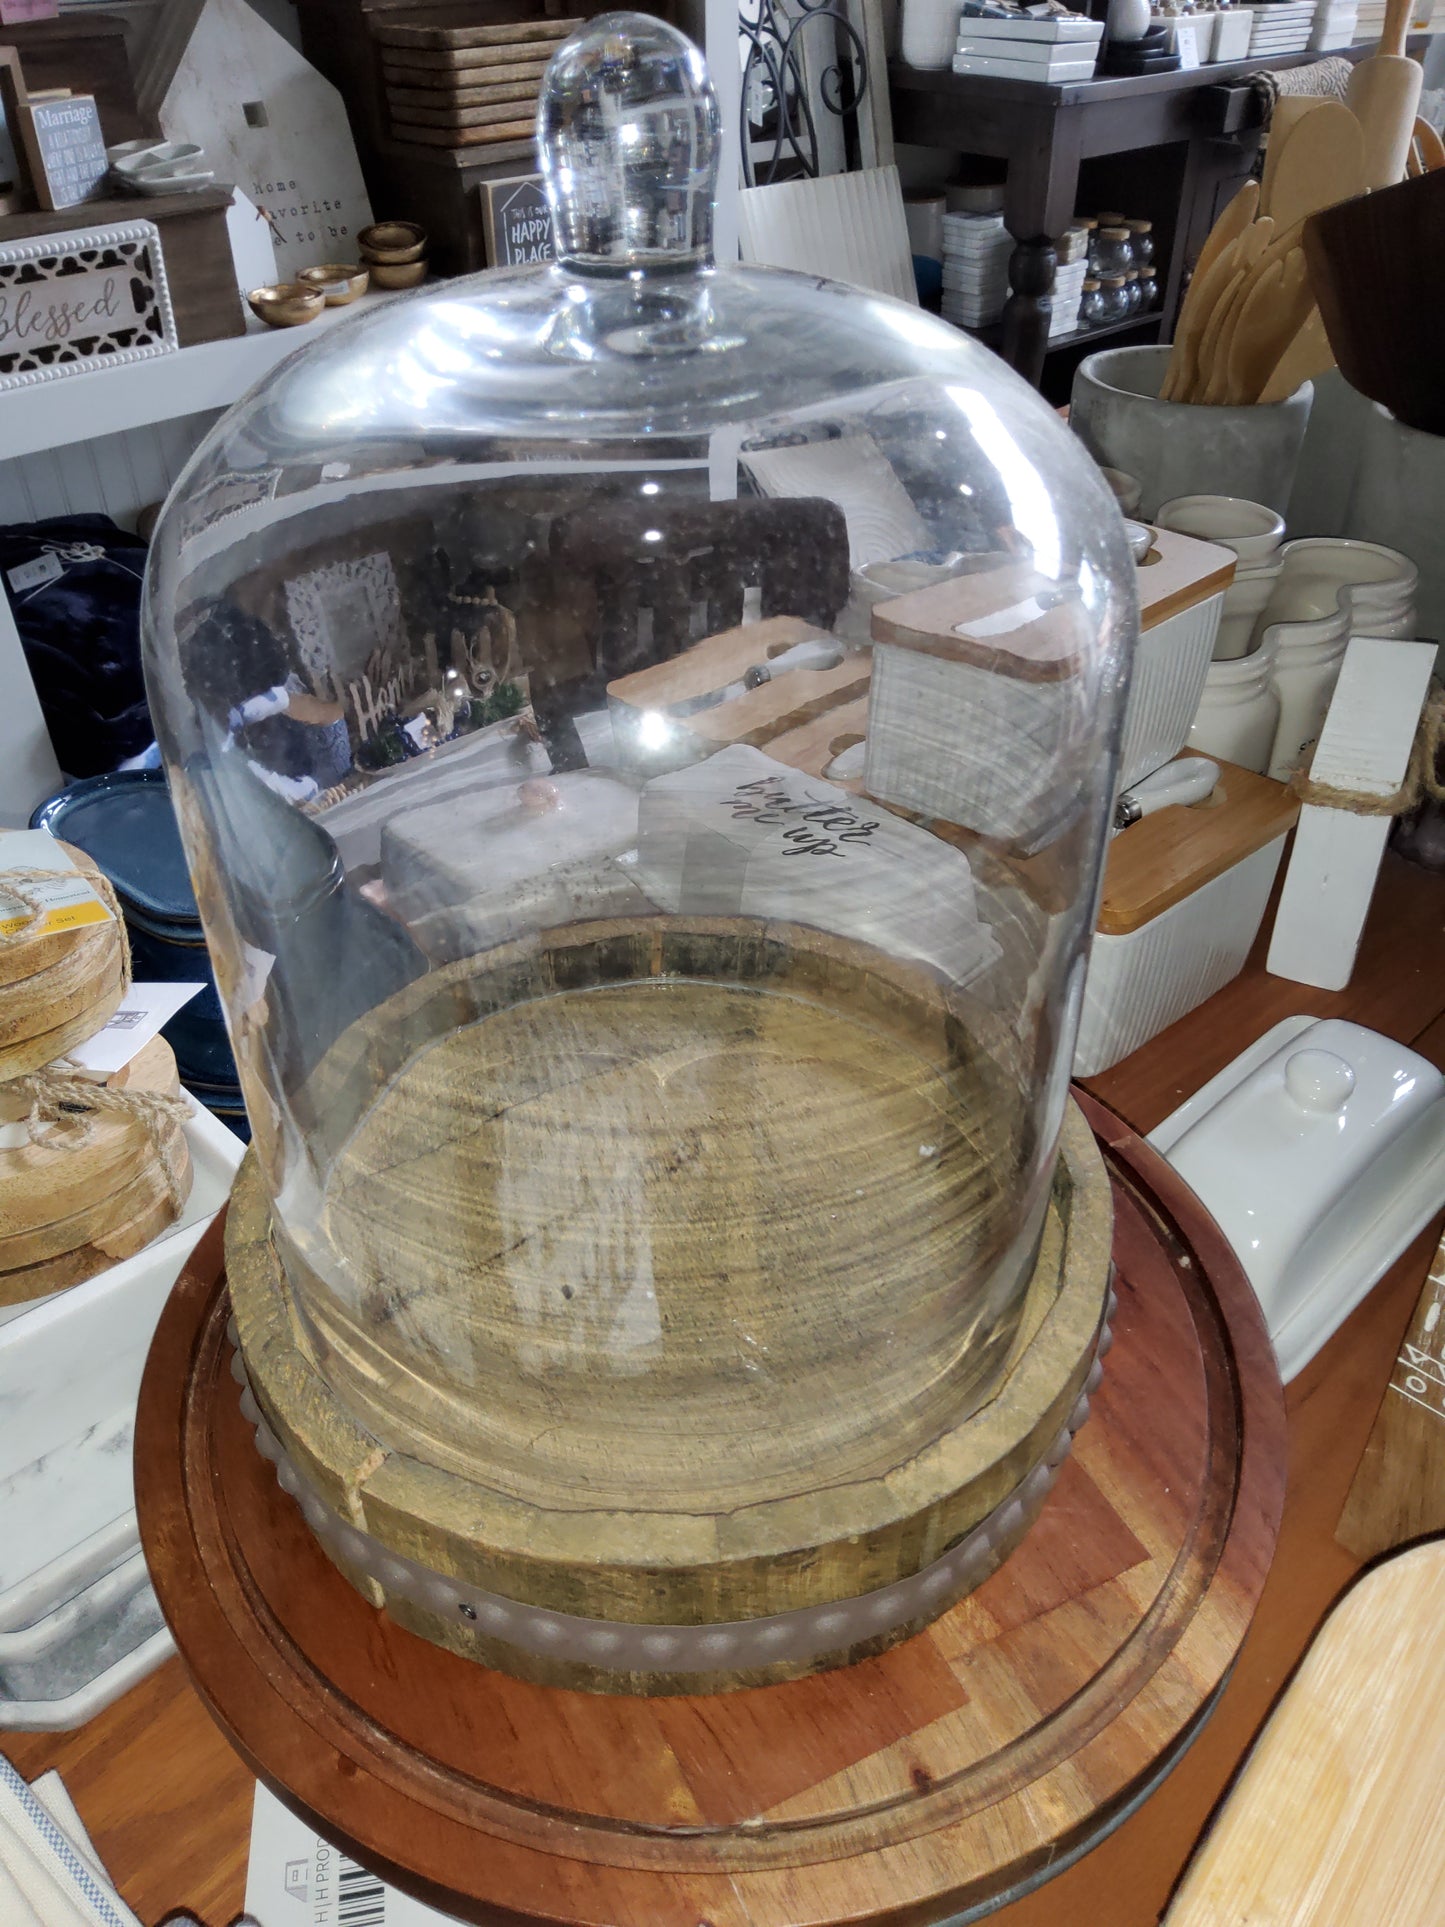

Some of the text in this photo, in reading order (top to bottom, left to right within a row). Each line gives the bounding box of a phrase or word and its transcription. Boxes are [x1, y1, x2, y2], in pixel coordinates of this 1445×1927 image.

[38, 104, 94, 129] Marriage
[253, 179, 297, 195] home
[268, 199, 342, 221] avorite
[296, 231, 316, 243] to
[328, 225, 348, 238] be
[512, 216, 550, 244] HAPPY
[515, 242, 552, 264] PLACE
[719, 799, 847, 858] me up
